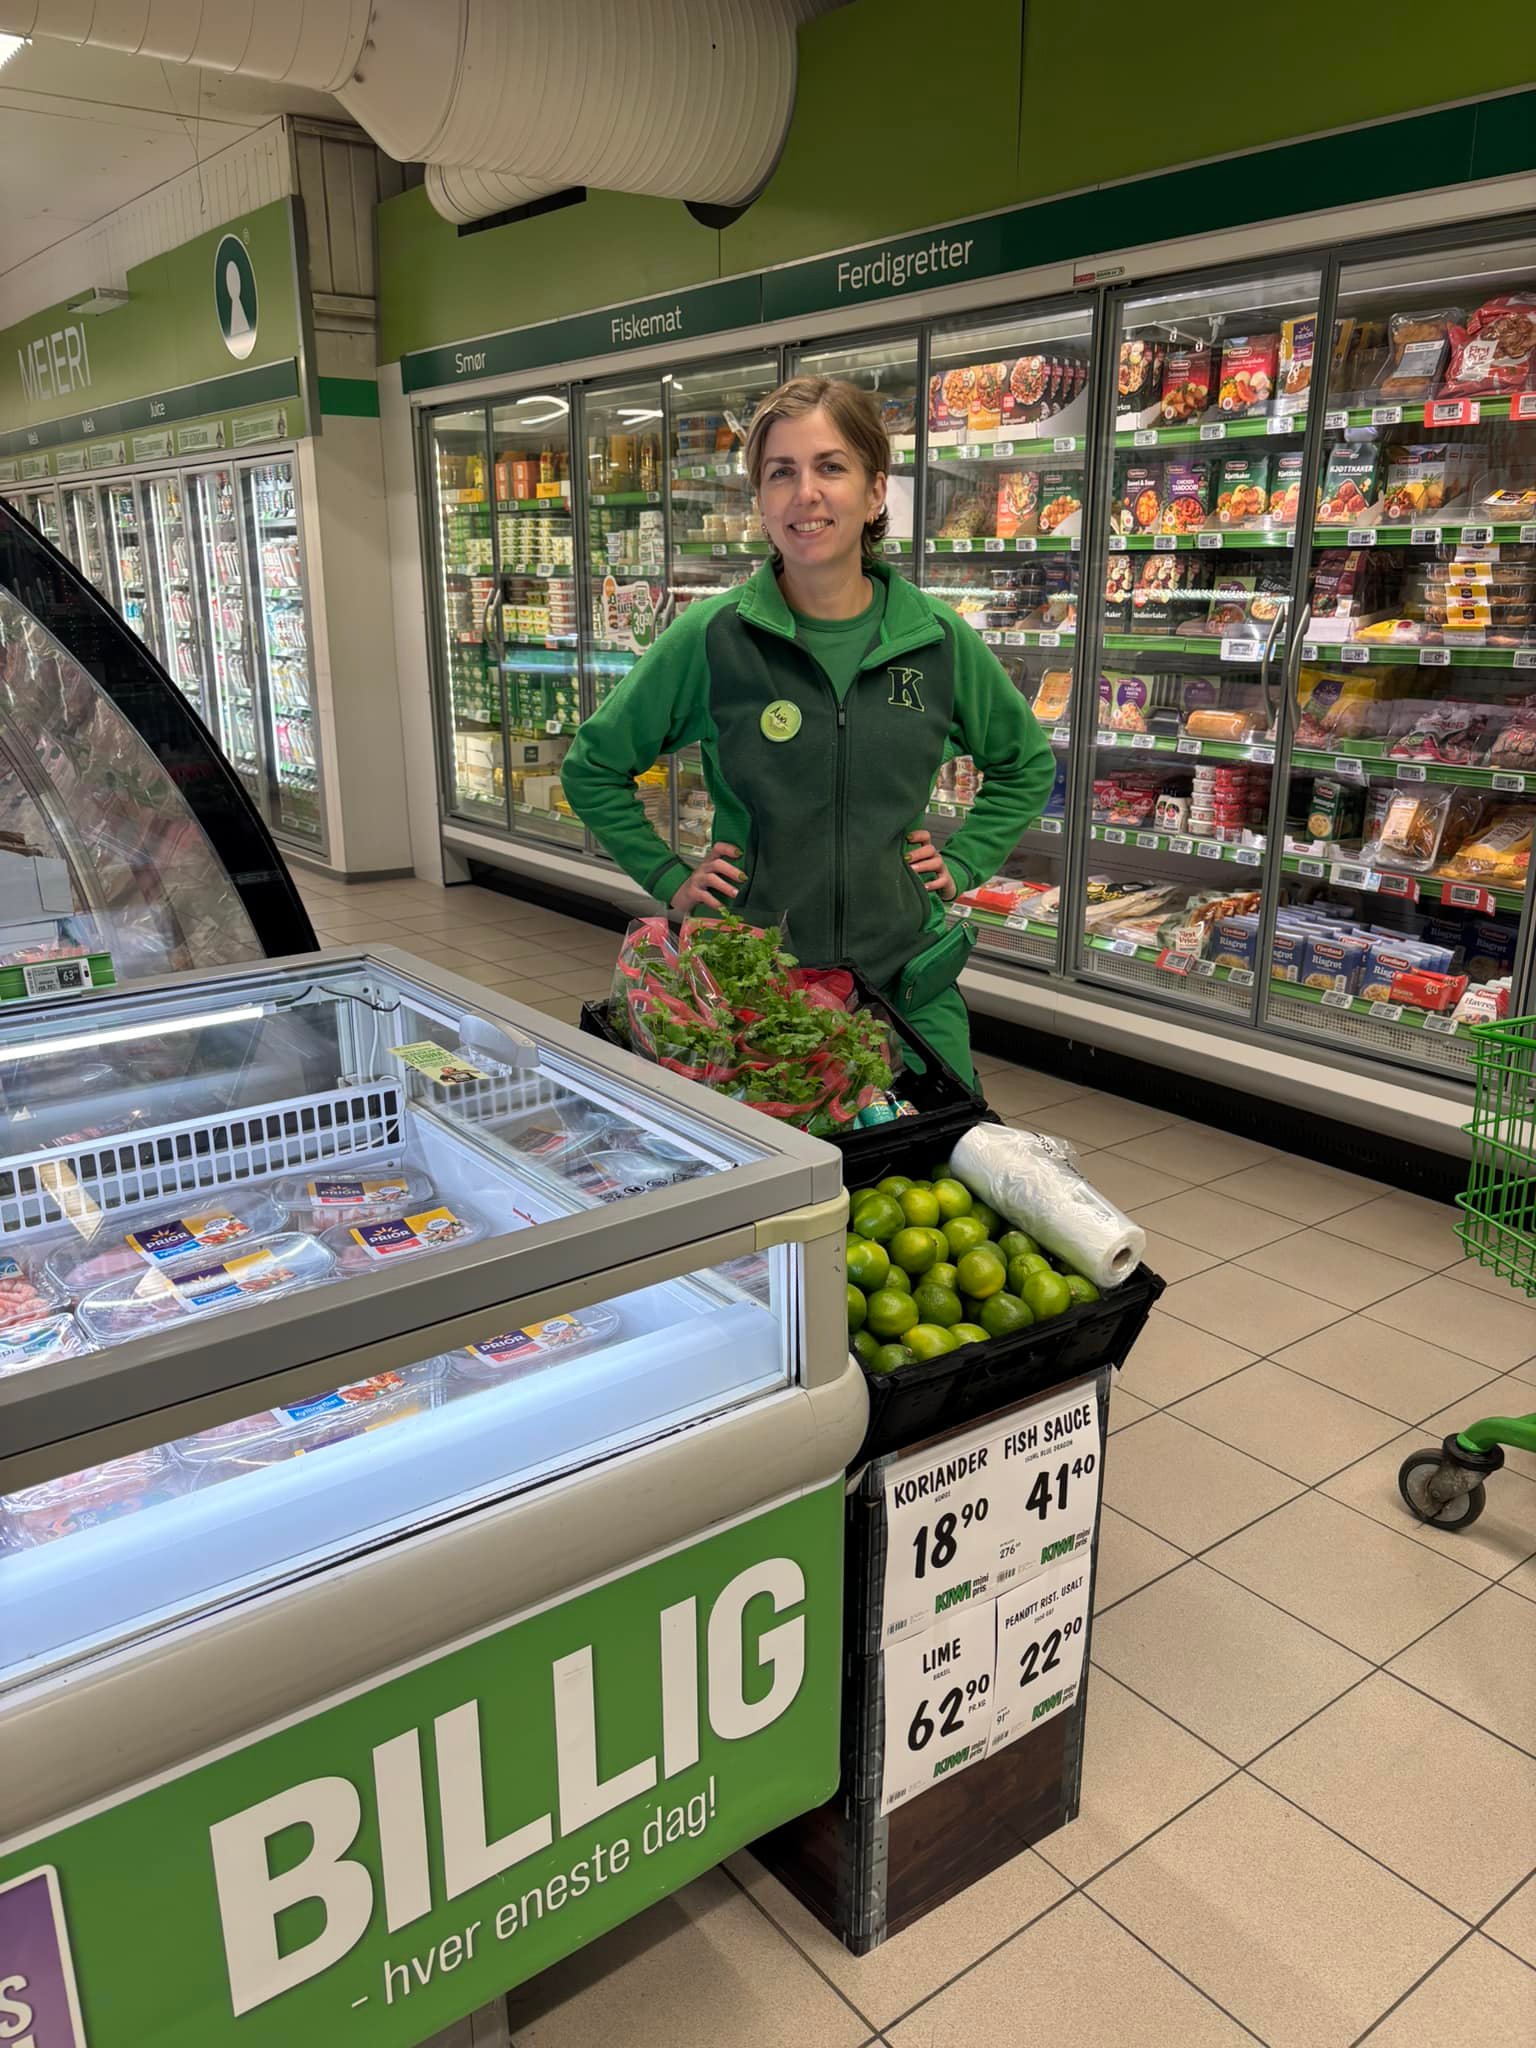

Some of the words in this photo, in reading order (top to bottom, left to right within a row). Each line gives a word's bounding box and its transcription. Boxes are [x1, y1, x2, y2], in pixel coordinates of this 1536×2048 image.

[838, 239, 974, 293] Ferdigretter
[610, 306, 683, 344] Fiskemat
[18, 322, 92, 402] MEIERI
[455, 351, 487, 374] Smør
[887, 666, 925, 712] K
[145, 1231, 190, 1249] PRIOR
[368, 1229, 412, 1244] PRIOR
[479, 1333, 526, 1353] PRIOR
[1004, 1425, 1038, 1460] FISH
[1043, 1404, 1092, 1443] SAUCE
[894, 1447, 989, 1509] KORIANDER
[1040, 1533, 1076, 1566] KIWI
[1074, 1537, 1088, 1551] pris
[1075, 1525, 1091, 1541] mini
[935, 1579, 972, 1615] KIWI
[972, 1572, 989, 1588] mini
[972, 1584, 987, 1599] pris
[1004, 1600, 1039, 1630] PEANØTT
[1040, 1590, 1060, 1609] RIST.
[1061, 1574, 1084, 1597] USALT
[922, 1637, 962, 1675] LIME
[1031, 1688, 1064, 1723] KIWI
[932, 1743, 971, 1779] KIWI
[208, 1556, 807, 2019] BILLIG
[381, 1919, 483, 2007] hver
[495, 1834, 632, 1941] eneste
[642, 1775, 719, 1858] dag!
